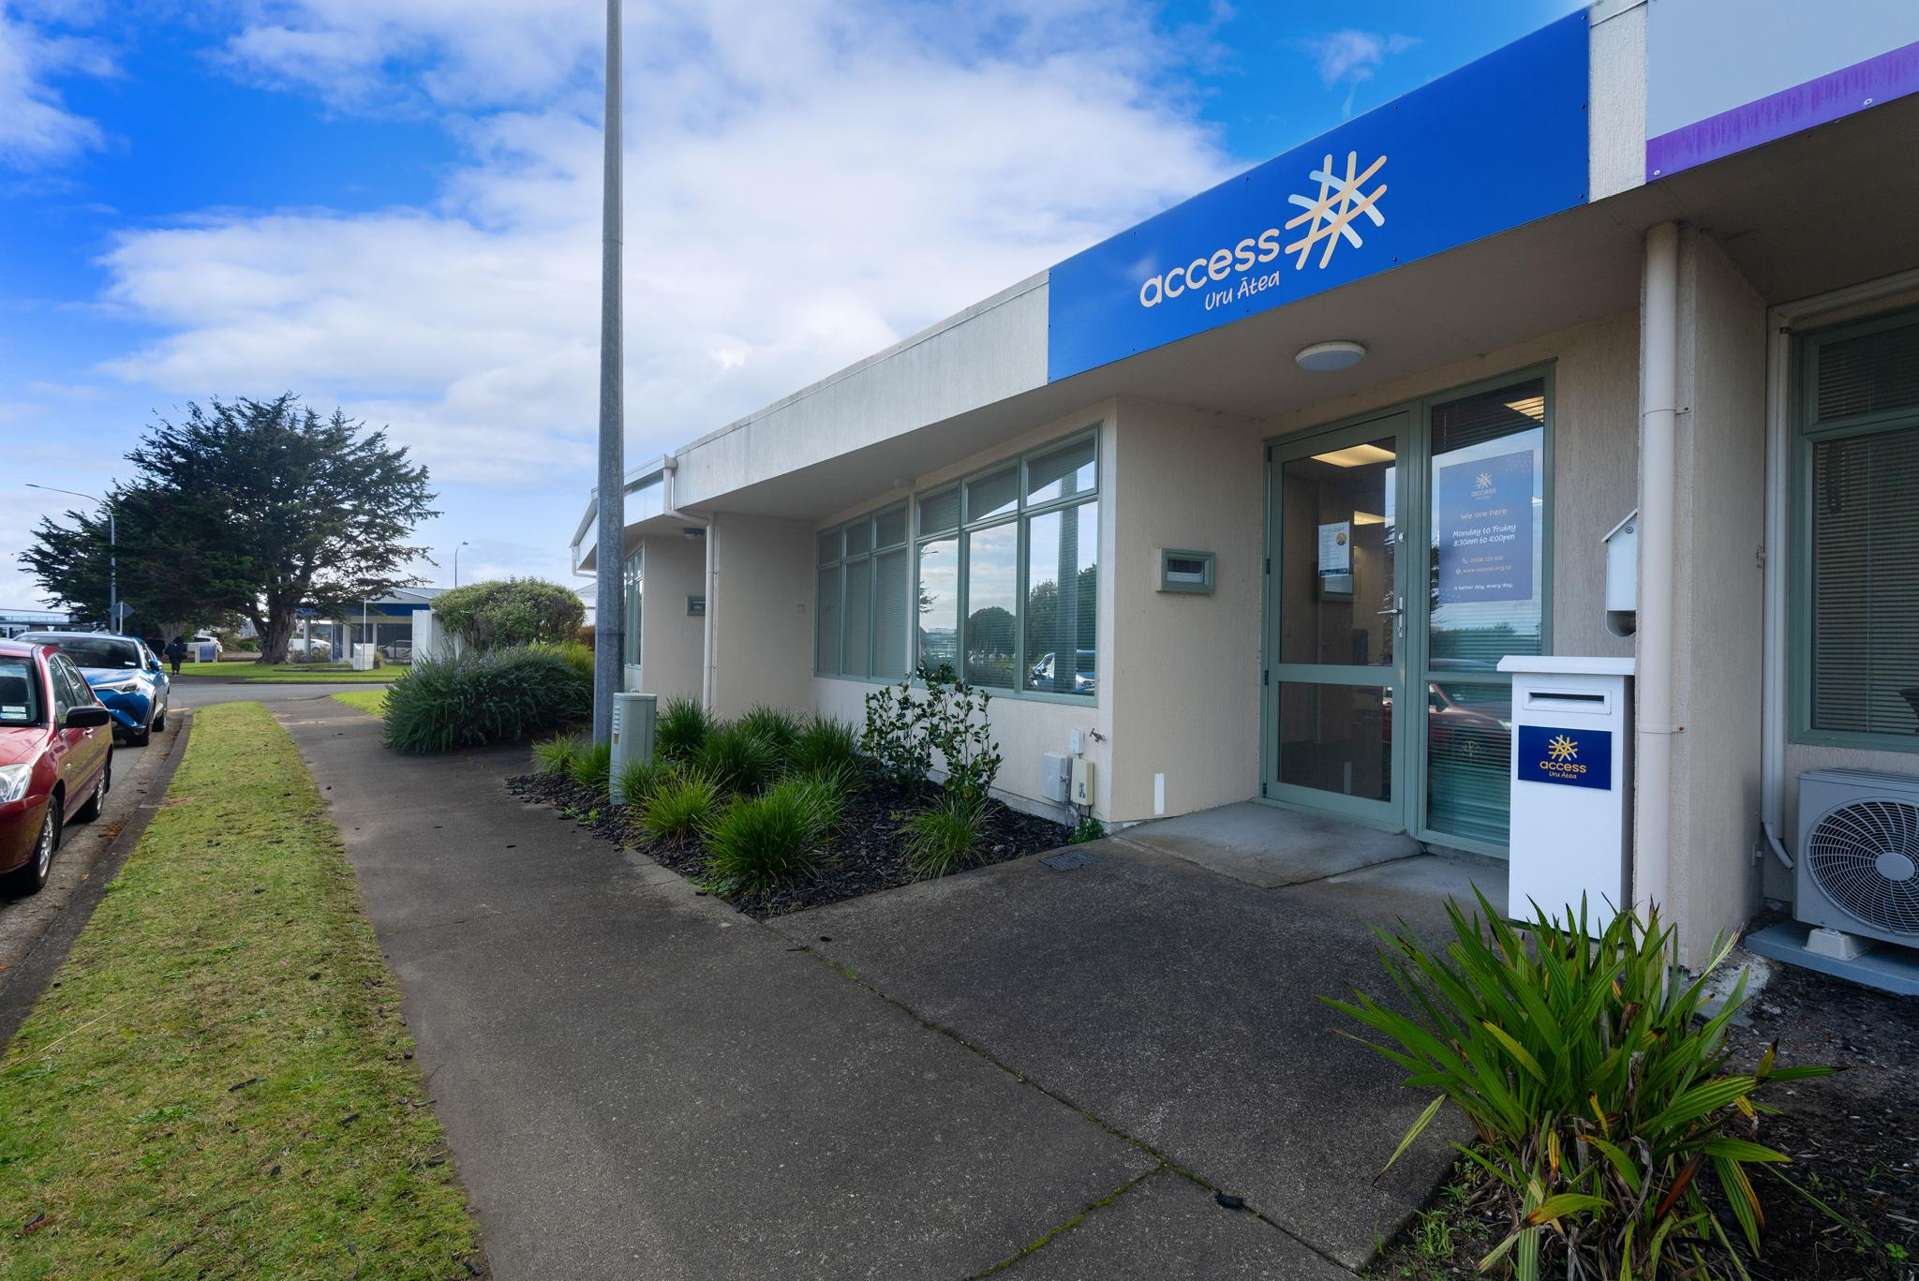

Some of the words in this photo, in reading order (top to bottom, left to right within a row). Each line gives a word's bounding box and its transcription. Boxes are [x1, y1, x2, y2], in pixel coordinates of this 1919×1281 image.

[1140, 228, 1281, 307] access
[1205, 286, 1233, 311] Uru
[1237, 270, 1280, 299] Ātea
[1452, 528, 1481, 538] Monday
[1482, 526, 1491, 534] to
[1539, 761, 1587, 773] access
